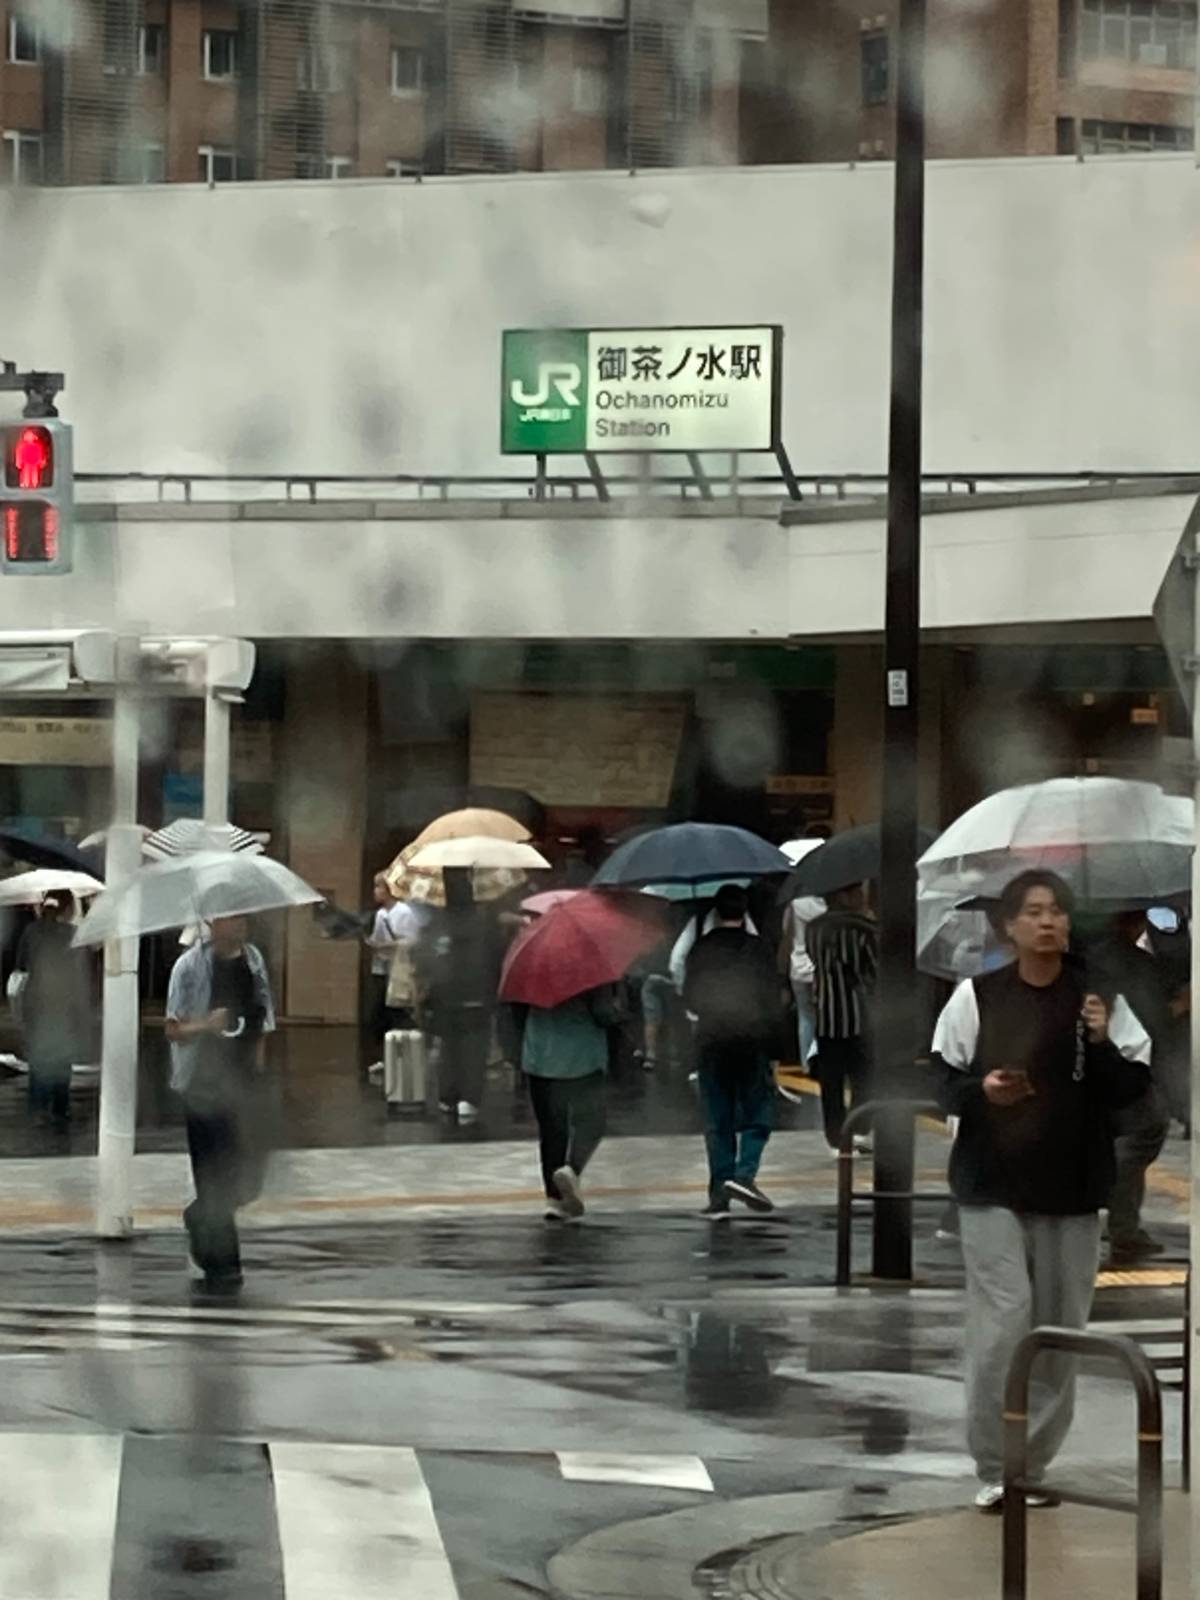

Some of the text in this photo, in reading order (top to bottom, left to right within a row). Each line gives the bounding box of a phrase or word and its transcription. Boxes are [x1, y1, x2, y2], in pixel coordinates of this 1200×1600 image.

[597, 345, 762, 381] 御茶ノ水駅
[511, 363, 581, 406] JR
[595, 390, 728, 409] Ochanomizu
[595, 418, 671, 437] Station
